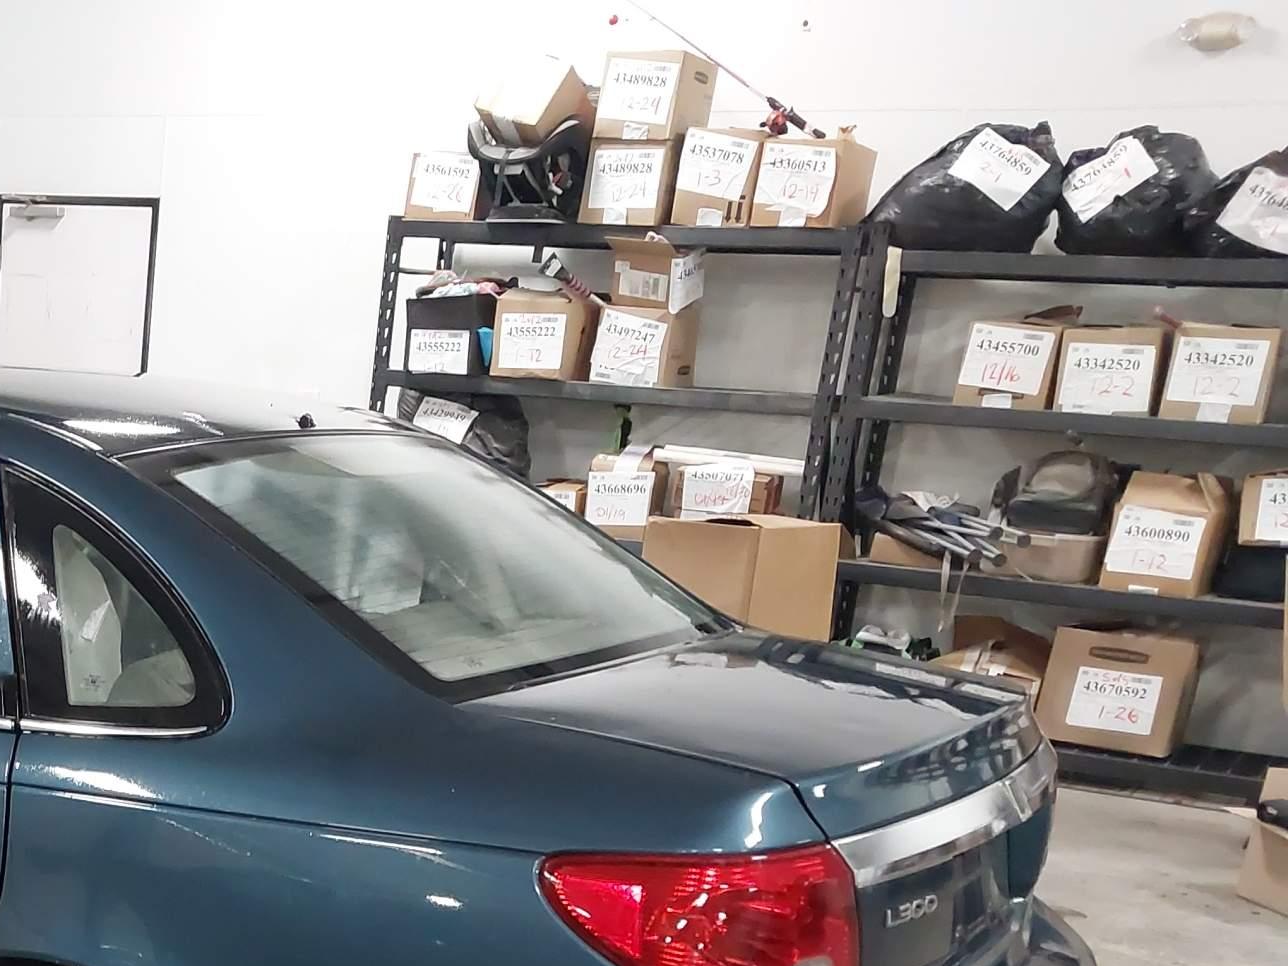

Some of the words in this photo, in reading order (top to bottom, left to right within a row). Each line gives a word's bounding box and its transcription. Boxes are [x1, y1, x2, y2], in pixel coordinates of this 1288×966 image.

[613, 72, 667, 88] 43489828
[690, 143, 745, 164] 43537078
[979, 140, 1032, 176] 43764859
[424, 163, 470, 179] 43561592
[599, 162, 653, 175] 43489828
[769, 158, 827, 173] 43360513
[697, 169, 721, 188] 1-3
[507, 326, 556, 337] 43555222
[606, 323, 656, 344] 43497247
[415, 341, 462, 353] 43555222
[976, 339, 1040, 356] 43455700
[1074, 357, 1141, 371] 43342520
[1184, 352, 1254, 367] 43342520
[593, 483, 647, 495] 43668696
[1124, 525, 1190, 542] 43600890
[1083, 680, 1147, 699] 43670592
[1098, 705, 1139, 724] 1-26
[886, 894, 938, 928] L300
